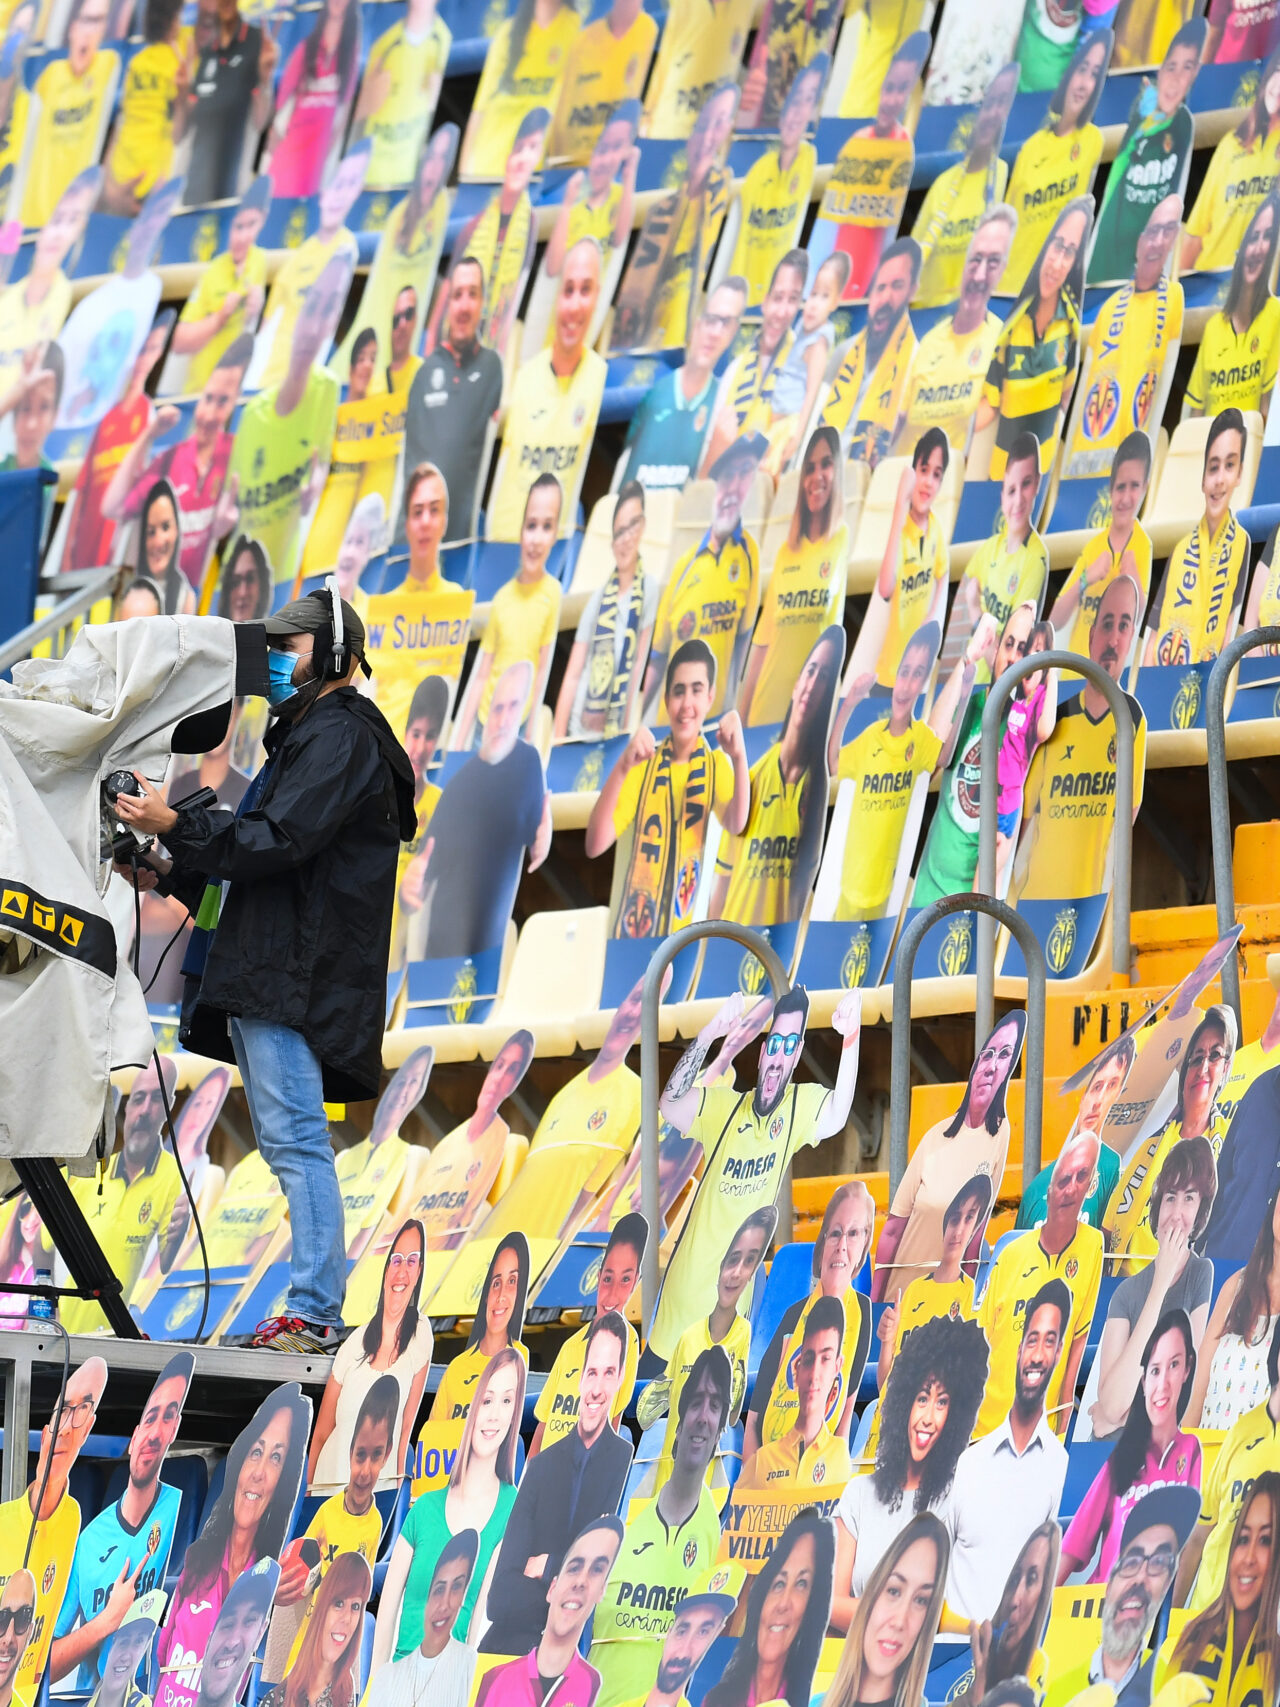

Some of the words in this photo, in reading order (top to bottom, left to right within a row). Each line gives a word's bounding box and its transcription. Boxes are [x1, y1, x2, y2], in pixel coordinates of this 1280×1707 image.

[1209, 359, 1262, 388] PAMESA
[915, 381, 973, 404] PAMESA
[777, 588, 831, 610] PAMESA
[862, 770, 914, 794] PAMESA
[1049, 771, 1116, 799] PAMESA
[722, 1152, 777, 1180] PAMESA
[415, 1190, 470, 1211] PAMESA
[728, 1536, 780, 1561] VILLA
